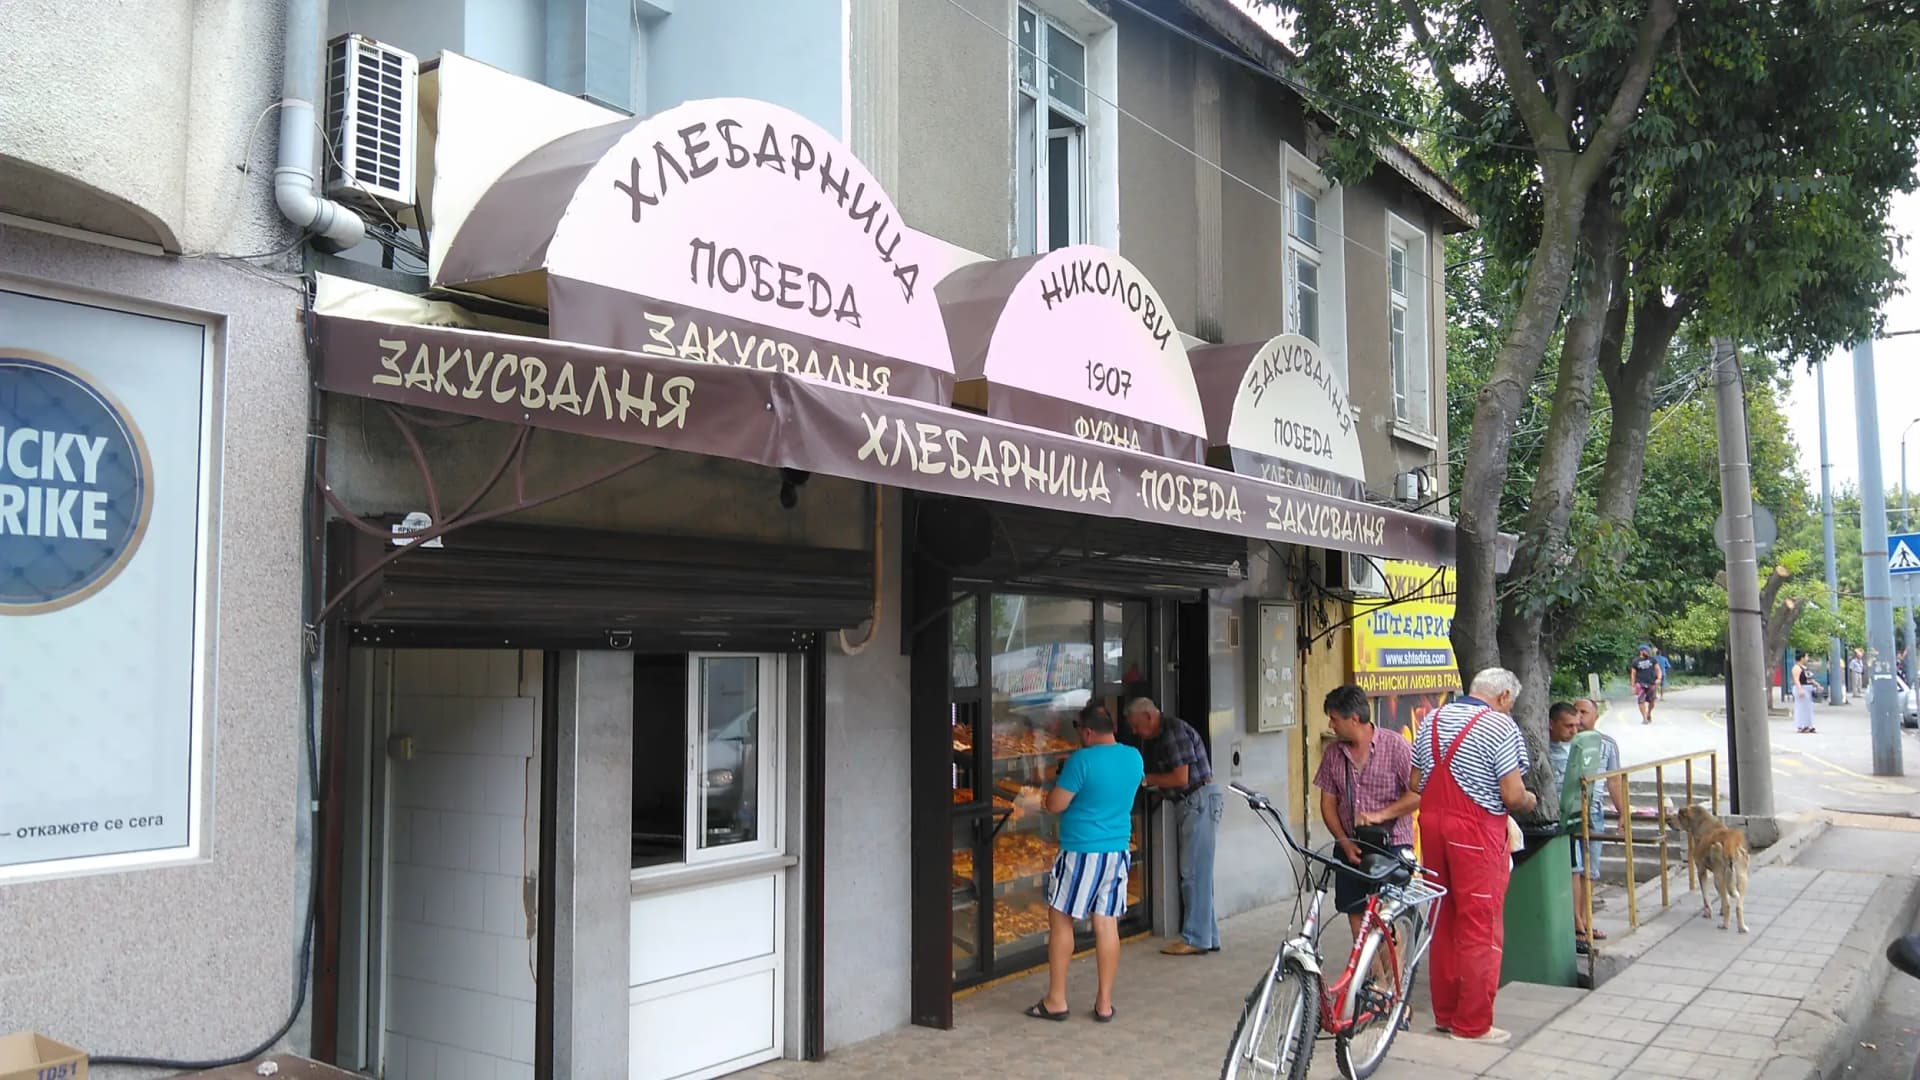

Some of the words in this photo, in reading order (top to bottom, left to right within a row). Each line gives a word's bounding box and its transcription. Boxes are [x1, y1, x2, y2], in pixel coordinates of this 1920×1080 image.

[614, 119, 921, 304] ХЛЕБАРНИЦА
[690, 238, 862, 329] ПОБЕДА
[1040, 259, 1171, 350] НИКОЛОВИ
[372, 339, 696, 430] ЗАКУСВАЛНЯ
[643, 312, 891, 396] ЗАКУСВАЛНЯ
[1085, 360, 1132, 400] 1907
[1247, 344, 1352, 437] ЗАКУСВАЛНЯ
[0, 426, 108, 484] CKY
[1075, 415, 1141, 450] ФУРНА
[1273, 417, 1333, 460] ПОБЕДА
[857, 412, 1112, 504] ХЛЕБАРНИЦА
[1139, 468, 1243, 523] ПОБЕДА
[1266, 494, 1386, 546] ЗАКУСВАЛНЯ
[1384, 650, 1446, 665] www.shtedria.com
[16, 819, 99, 839] откажете
[104, 818, 124, 830] се
[128, 814, 164, 829] сега
